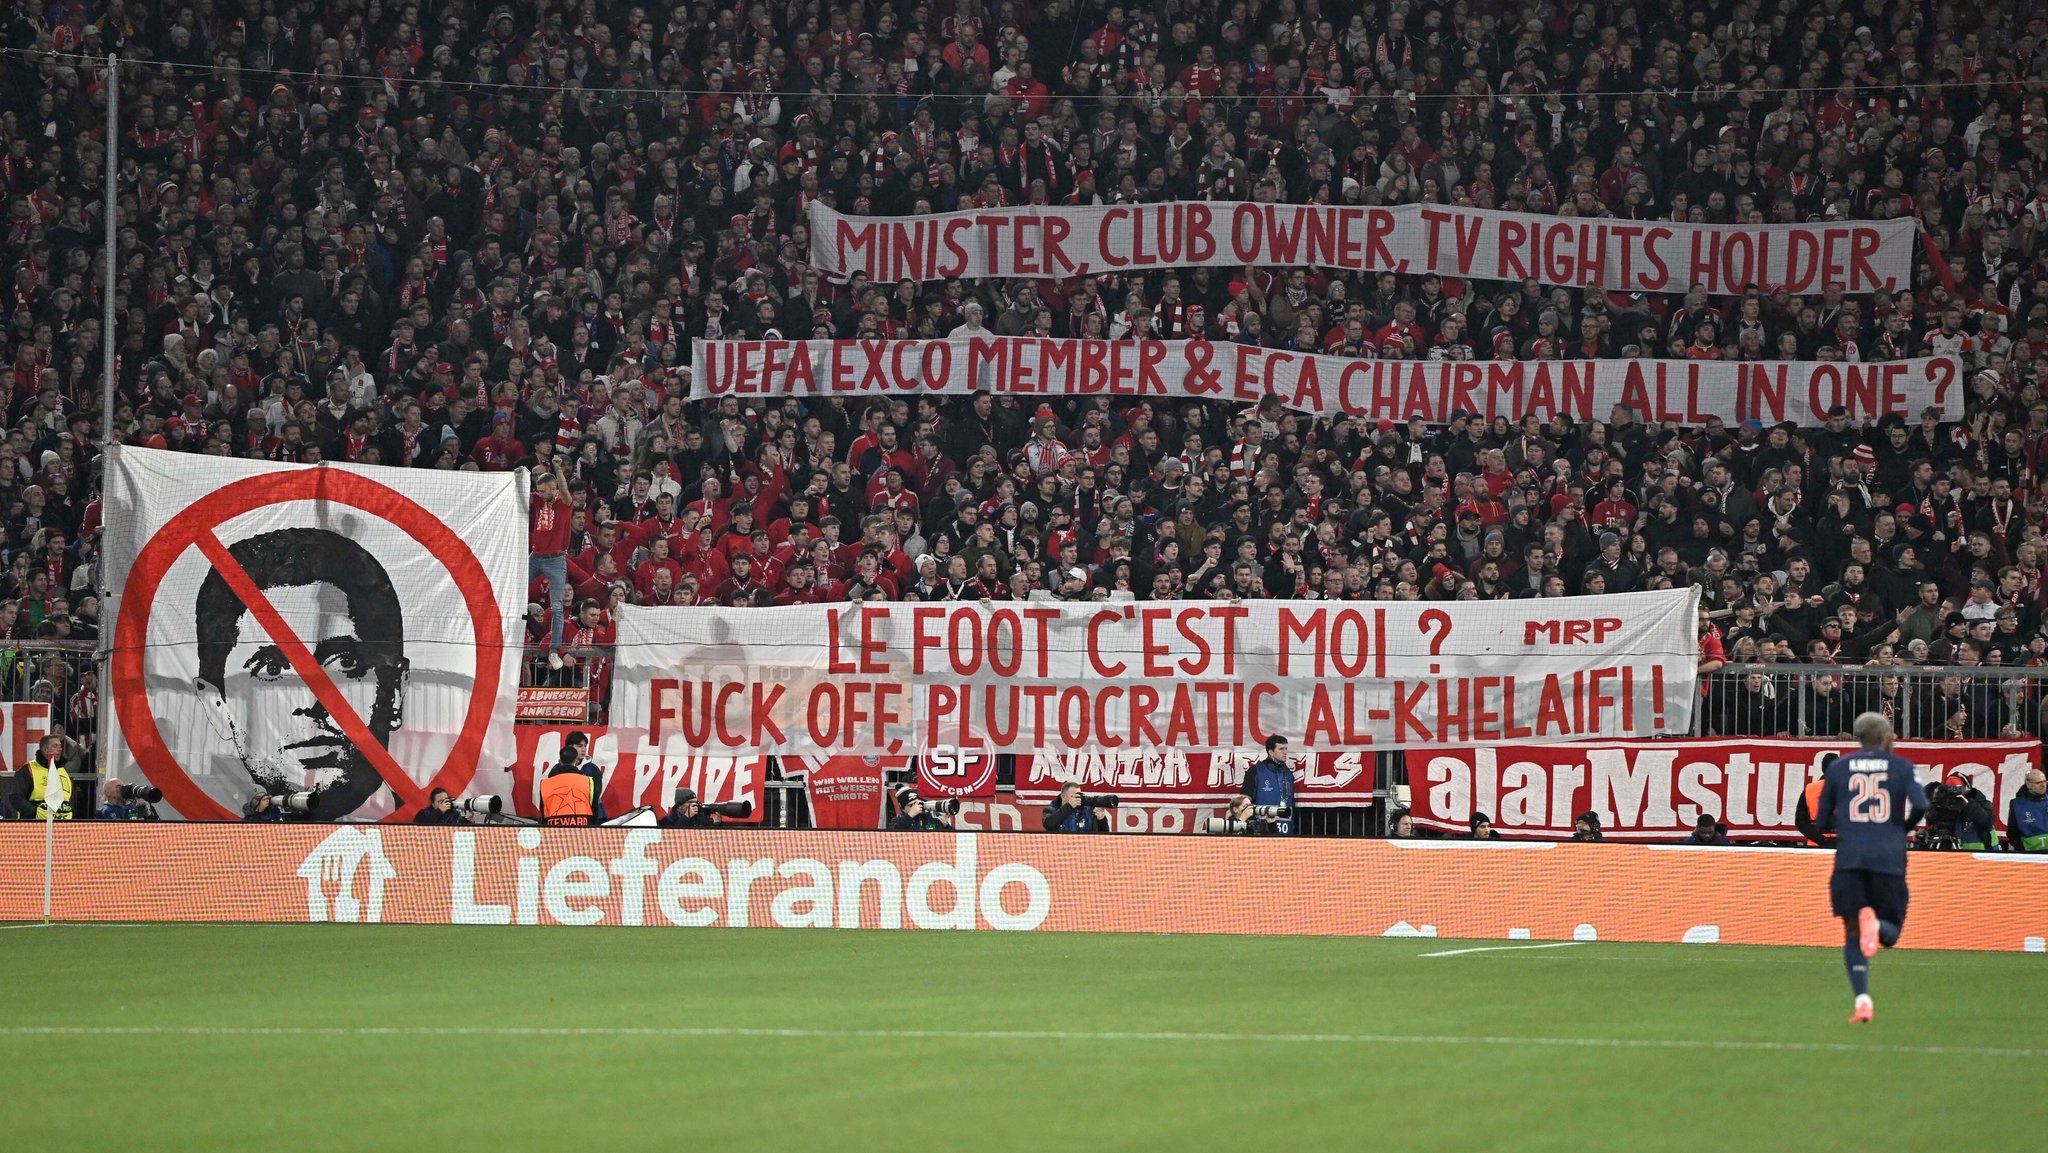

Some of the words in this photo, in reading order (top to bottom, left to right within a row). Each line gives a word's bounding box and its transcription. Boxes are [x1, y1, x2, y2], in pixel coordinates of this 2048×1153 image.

[838, 215, 1088, 280] MINISTER,
[1101, 206, 1214, 265] CLUB
[1232, 204, 1407, 273] OWNER,
[1422, 211, 1482, 273] TV
[1499, 222, 1670, 290] RIGHTS
[1690, 229, 1896, 293] HOLDER,
[707, 341, 815, 393] UEFA
[831, 338, 951, 391] EXCO
[968, 338, 1168, 395] MEMBER
[1184, 340, 1222, 394] &
[1236, 346, 1323, 412] ECA
[1339, 362, 1596, 423] CHAIRMAN
[1622, 363, 1709, 422] ALL
[1737, 364, 1788, 422] IN
[1810, 364, 1908, 418] ONE
[827, 607, 891, 675] LE
[913, 606, 1061, 678] FOOT
[1087, 605, 1249, 678] C'EST
[1278, 607, 1386, 679] MOI
[1524, 617, 1623, 646] MRP
[520, 706, 583, 717] ANWESEND
[529, 690, 587, 701] ABWESEND
[648, 678, 787, 748] FUCK
[806, 682, 905, 756] OFF,
[927, 682, 1280, 750] PLUTOCRATIC
[632, 733, 758, 814] PRIDE
[930, 745, 979, 777] SF
[1029, 745, 1192, 788] MUNICH
[1206, 748, 1363, 788] REELS
[813, 777, 835, 787] WIR
[836, 776, 880, 785] WOLLEN
[815, 785, 879, 795] ROT-WEISSE
[828, 792, 869, 802] TRIKOTS
[939, 784, 974, 797] FCBM
[1848, 772, 1891, 824] 25
[451, 827, 1051, 931] Lieferando
